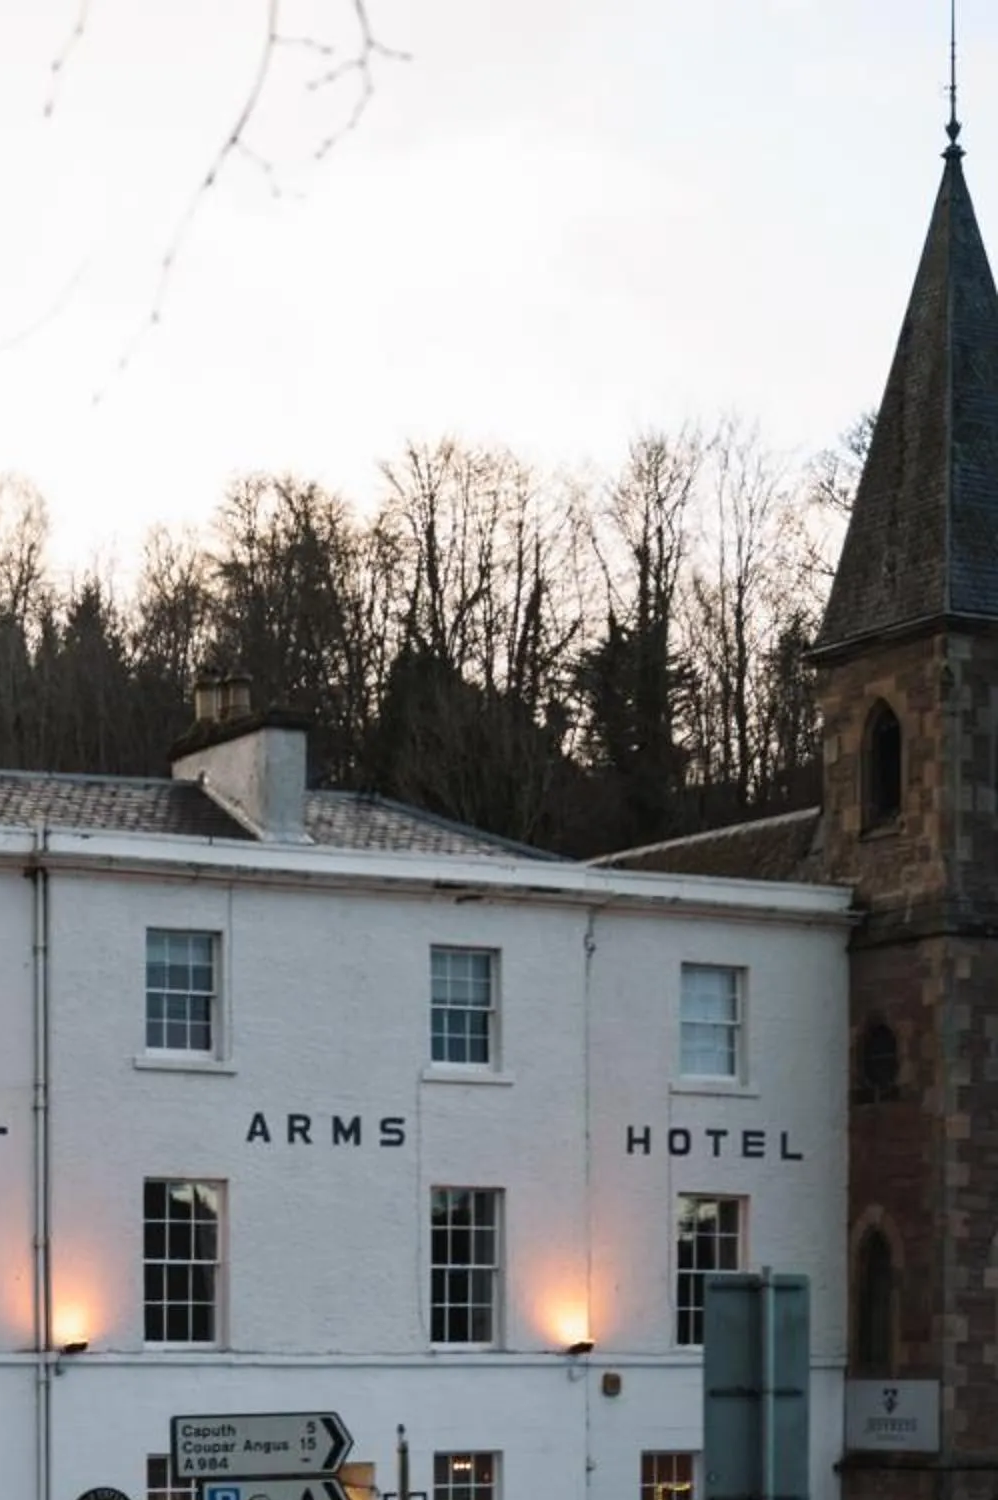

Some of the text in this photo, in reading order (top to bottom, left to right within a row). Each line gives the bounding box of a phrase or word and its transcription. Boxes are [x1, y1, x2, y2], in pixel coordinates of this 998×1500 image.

[245, 1112, 407, 1148] ARMS
[626, 1125, 804, 1161] HOTEL
[181, 1421, 317, 1439] Caputh 5
[182, 1437, 317, 1455] Coupar Angus 15
